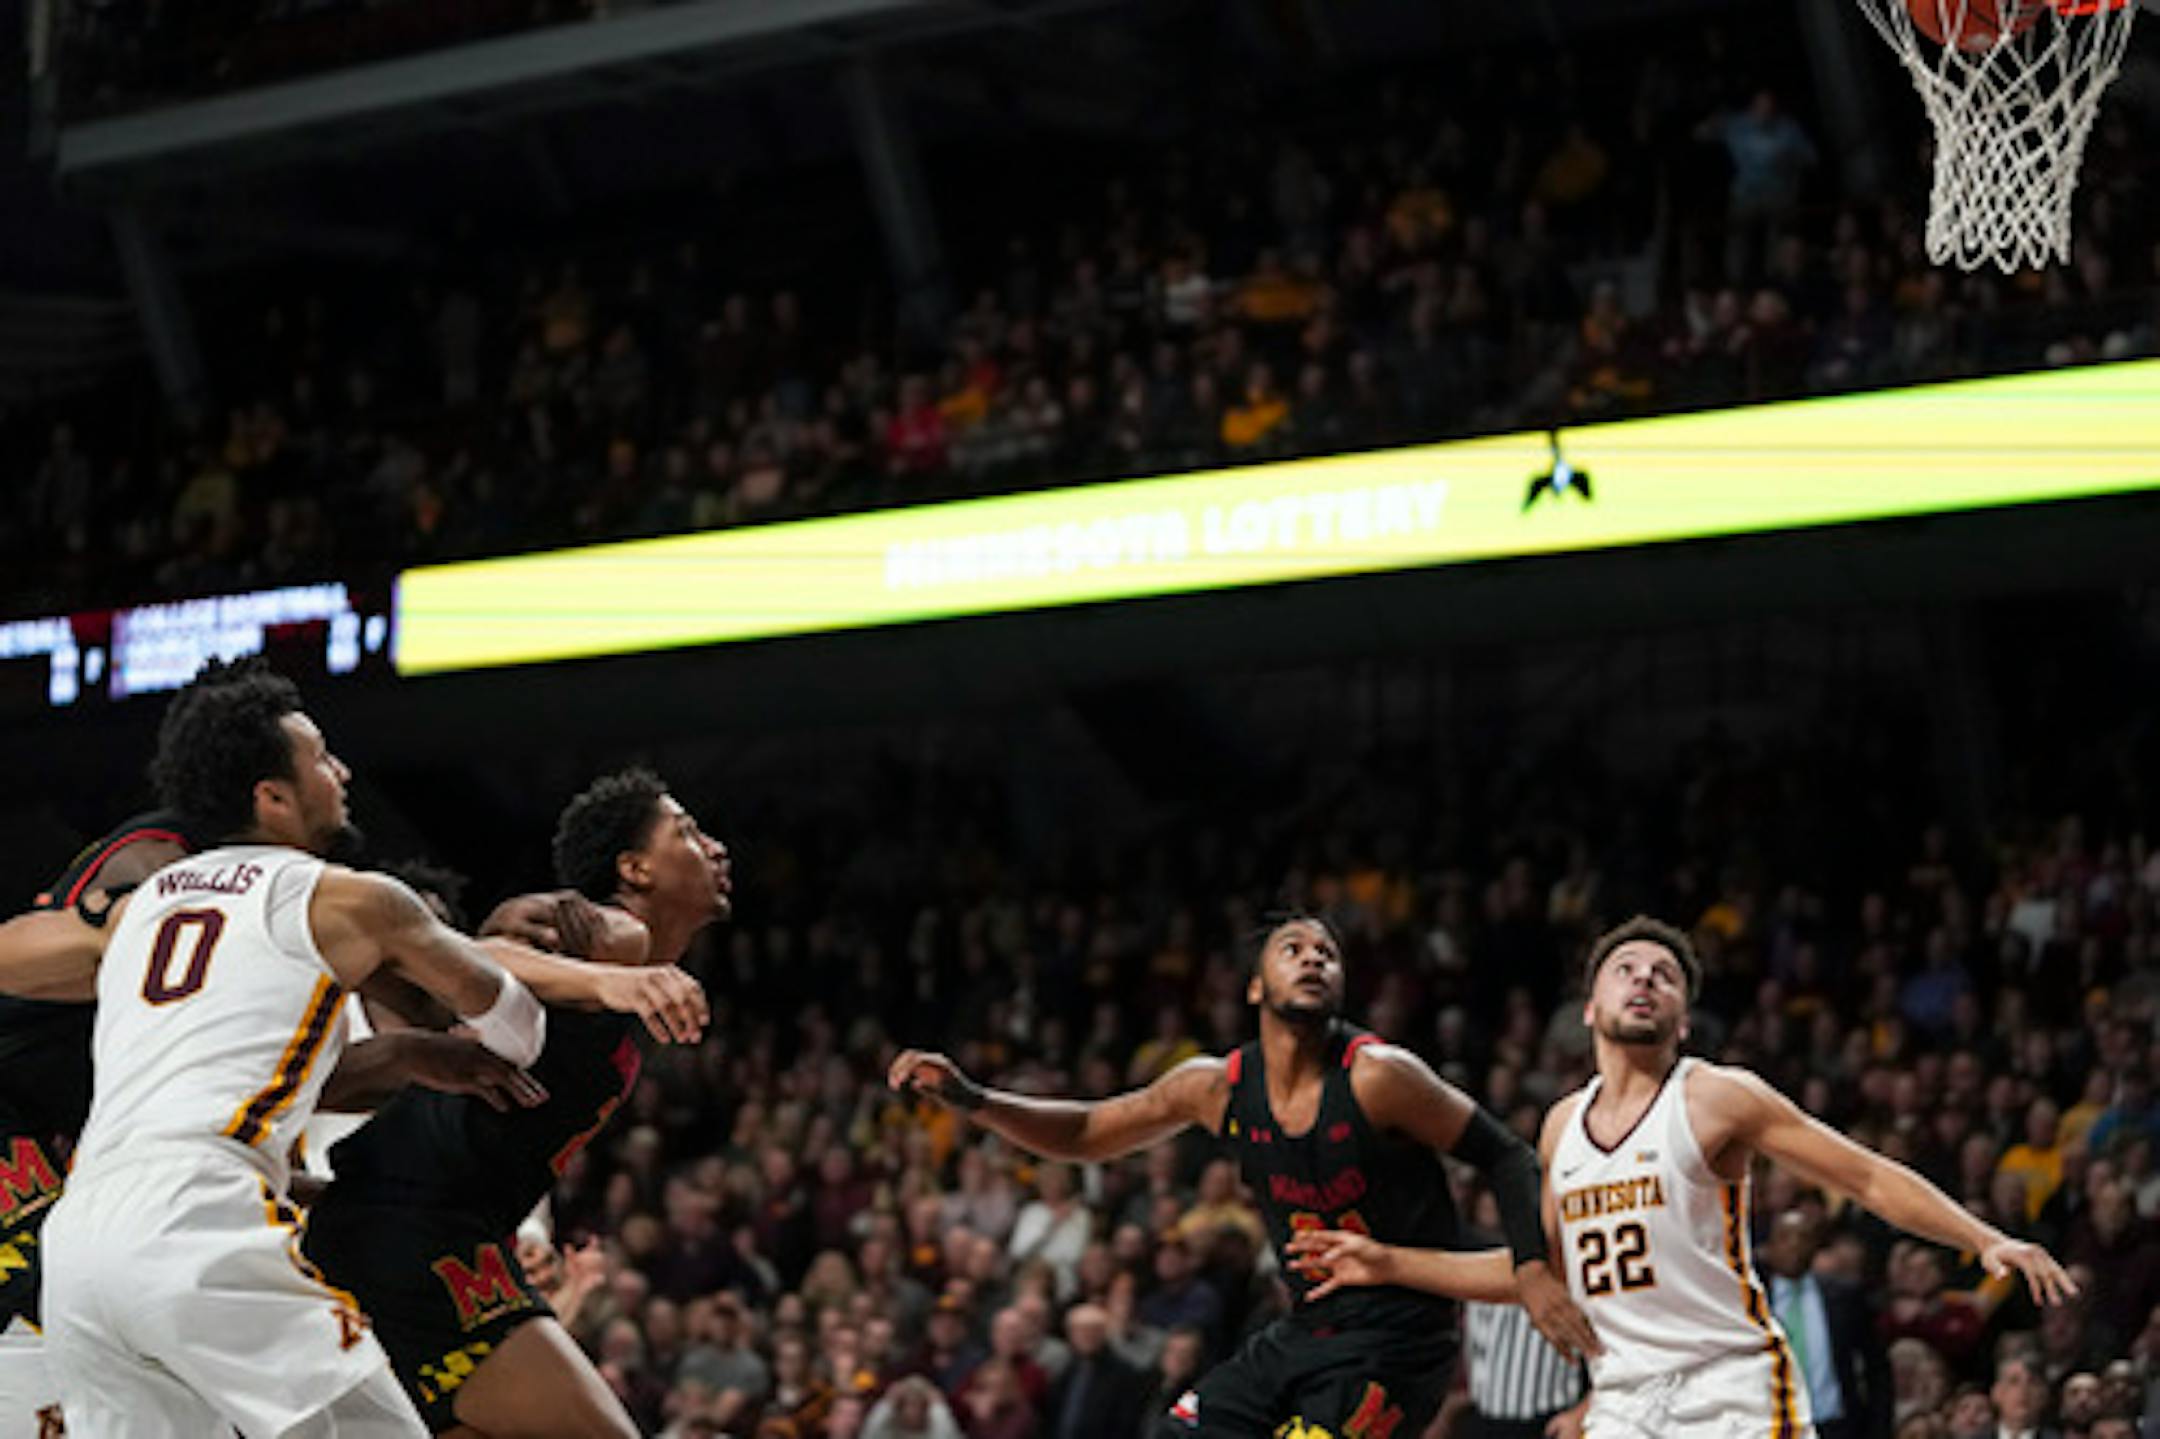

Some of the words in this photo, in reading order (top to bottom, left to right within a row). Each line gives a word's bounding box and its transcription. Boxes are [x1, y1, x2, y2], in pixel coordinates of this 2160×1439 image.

[1203, 479, 1448, 553] LOTTERY
[156, 863, 263, 898] WILLIS
[139, 906, 227, 1007] 0
[1577, 1221, 1658, 1298] 22
